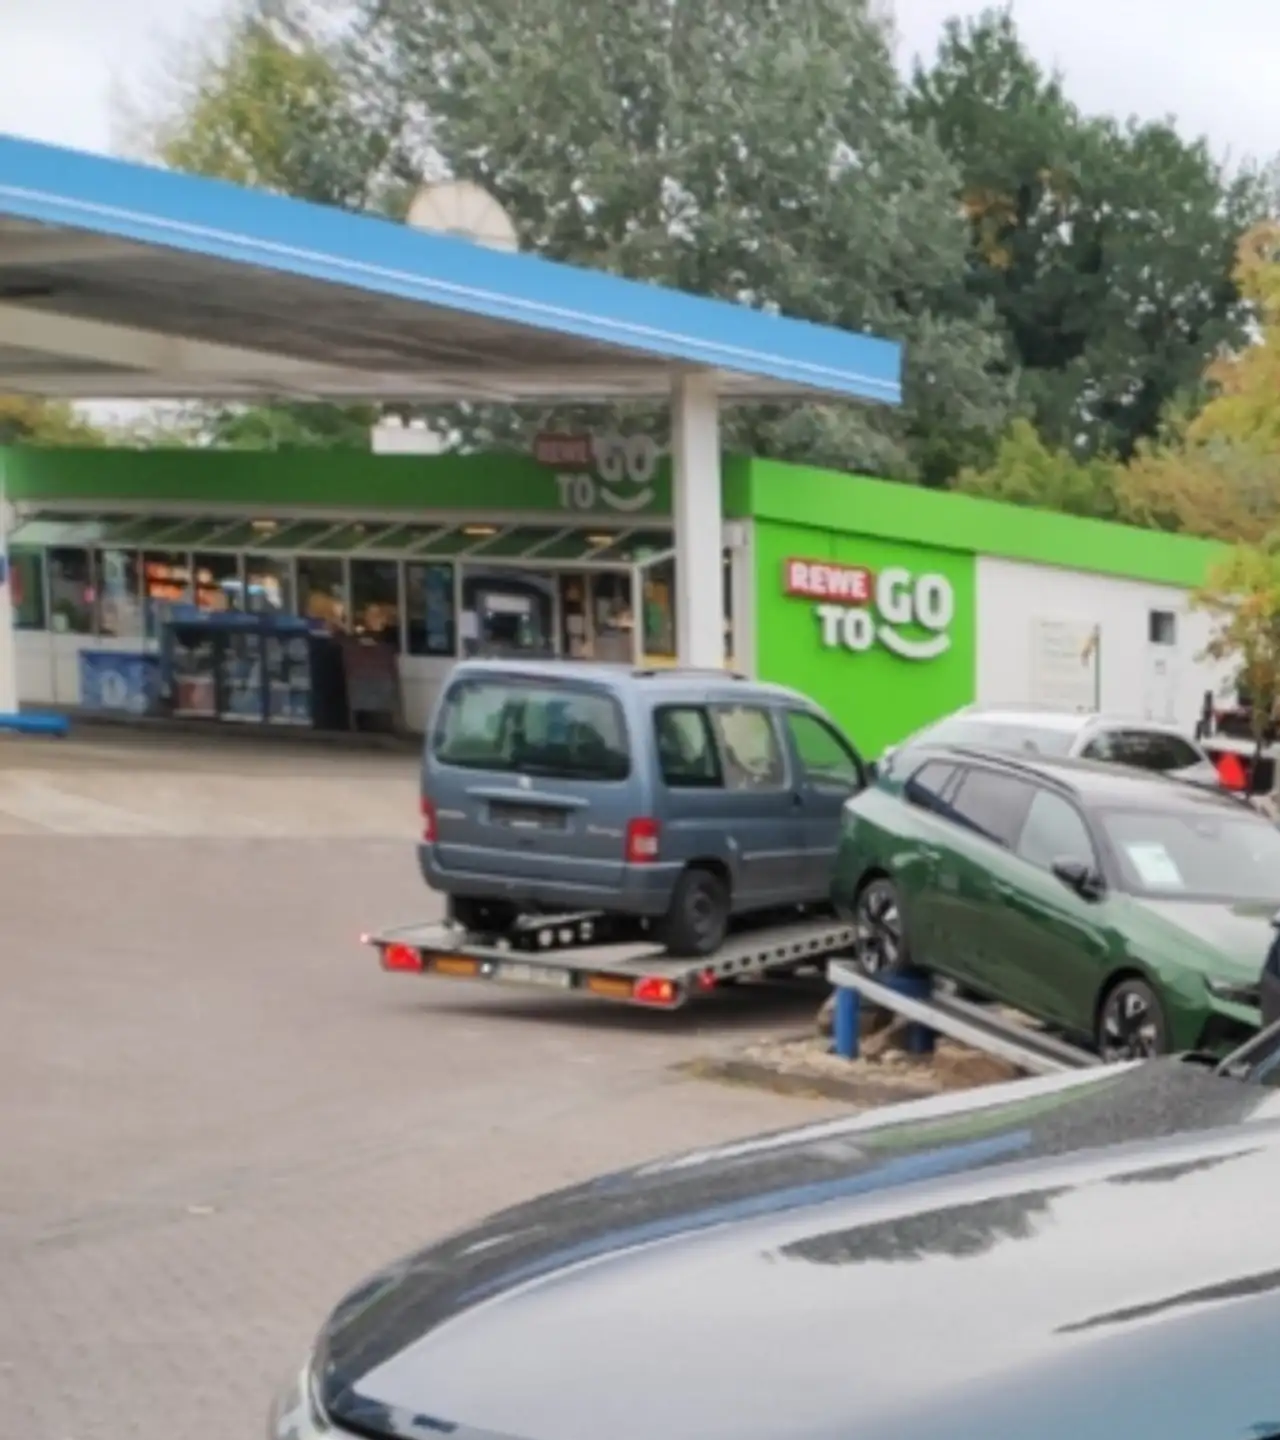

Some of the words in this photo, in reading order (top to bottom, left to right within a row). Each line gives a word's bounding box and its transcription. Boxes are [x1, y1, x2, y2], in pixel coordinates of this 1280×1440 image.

[555, 473, 595, 509] TO
[596, 434, 656, 482] GO
[790, 560, 869, 599] REWE
[817, 603, 874, 650] TO
[876, 565, 953, 631] GO
